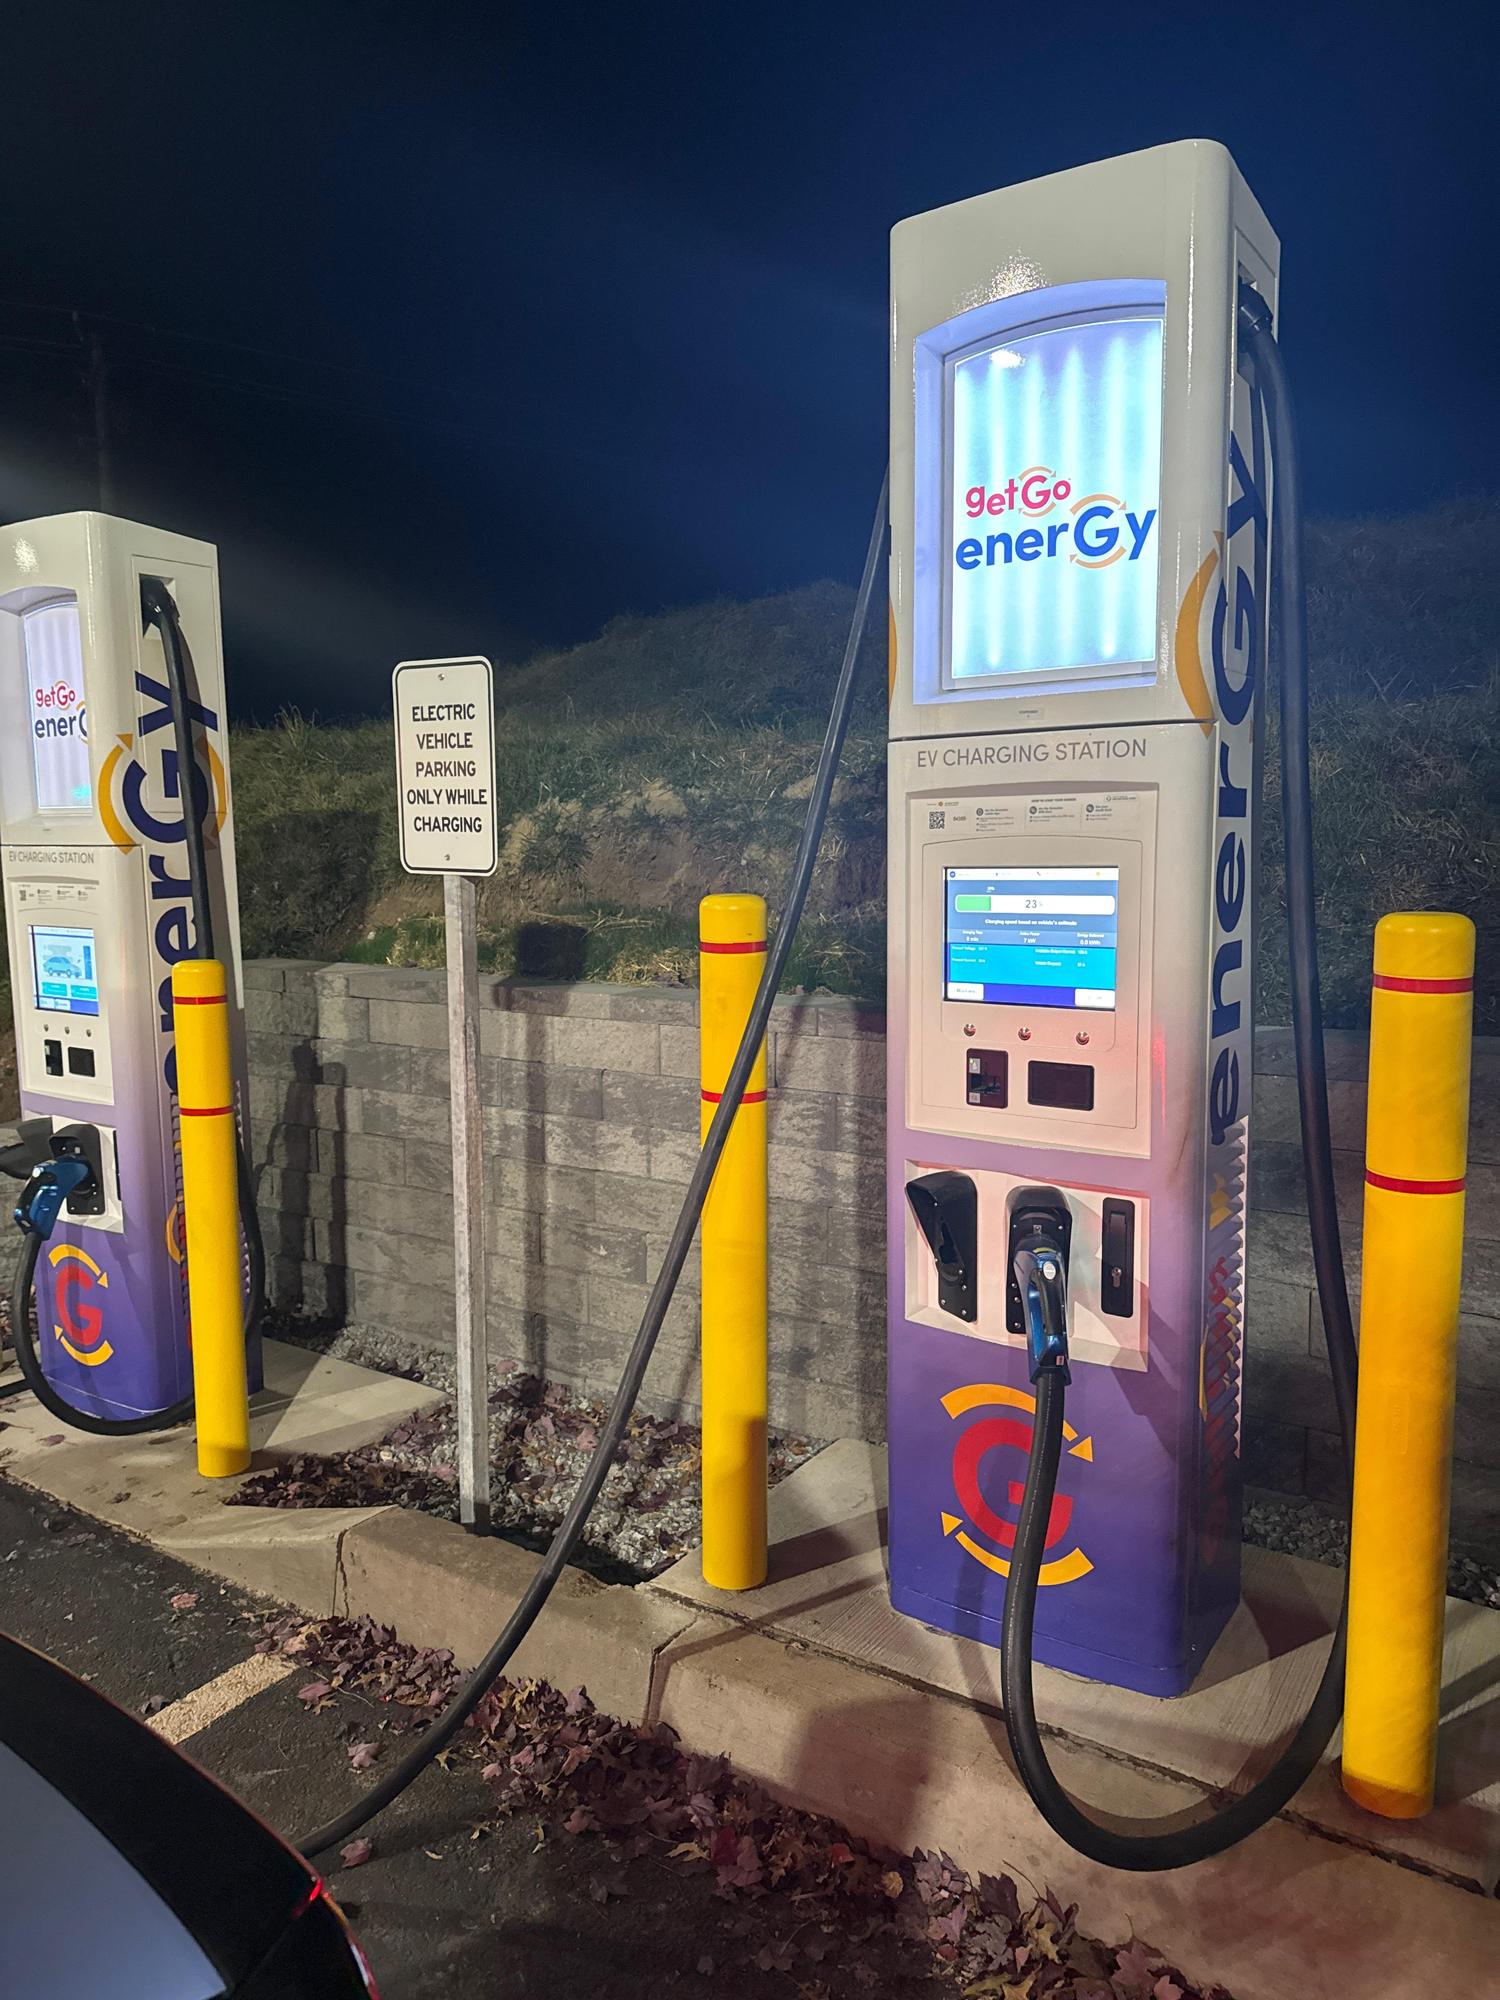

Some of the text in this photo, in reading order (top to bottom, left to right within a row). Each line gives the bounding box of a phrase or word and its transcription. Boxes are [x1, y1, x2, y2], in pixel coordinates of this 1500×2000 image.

[966, 475, 1071, 518] getGo
[955, 506, 1157, 570] enerGy
[35, 685, 76, 708] getGo
[412, 703, 476, 722] ELECTRIC
[416, 732, 473, 750] VEHICLE
[917, 738, 1147, 768] EV CHARGING STATION
[415, 760, 476, 778] PARKING
[406, 788, 488, 805] ONLY WHILE
[1208, 430, 1267, 1146] enerGy
[413, 816, 483, 833] CHARGING
[18, 851, 57, 863] CHARGING
[59, 852, 94, 864] STATION
[122, 671, 218, 1093] erGy
[1025, 899, 1037, 909] 23
[54, 1266, 103, 1347] G
[953, 1418, 1073, 1551] G
